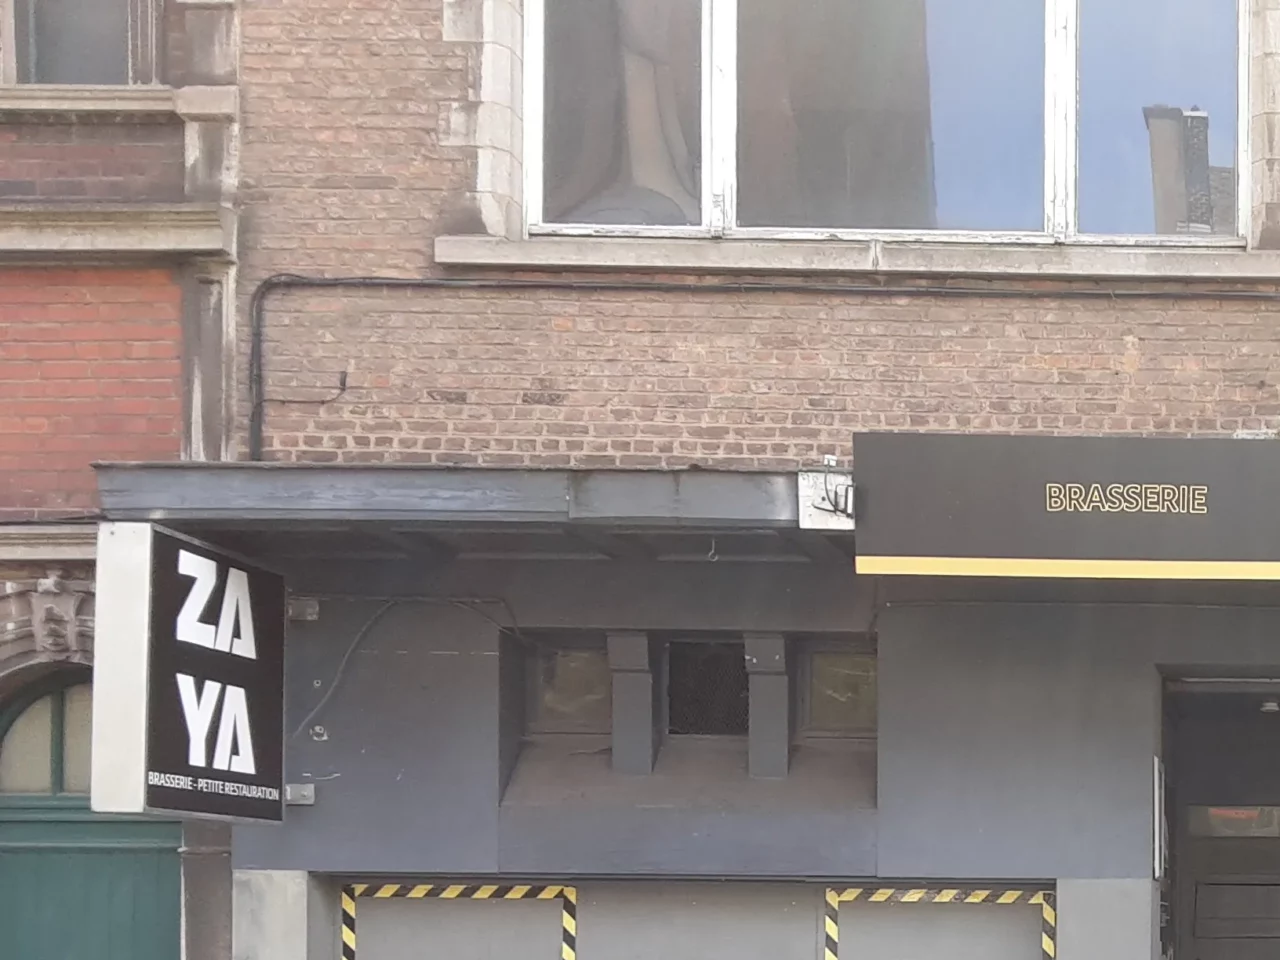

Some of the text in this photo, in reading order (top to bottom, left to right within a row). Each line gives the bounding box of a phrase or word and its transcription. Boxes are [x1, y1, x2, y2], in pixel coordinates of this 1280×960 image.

[1045, 483, 1208, 514] BRASSERIE
[176, 549, 257, 660] ZA
[175, 672, 257, 775] YA
[147, 771, 194, 791] BRASSERIE
[197, 778, 225, 795] PETITE
[224, 781, 280, 801] RESTAURATION
